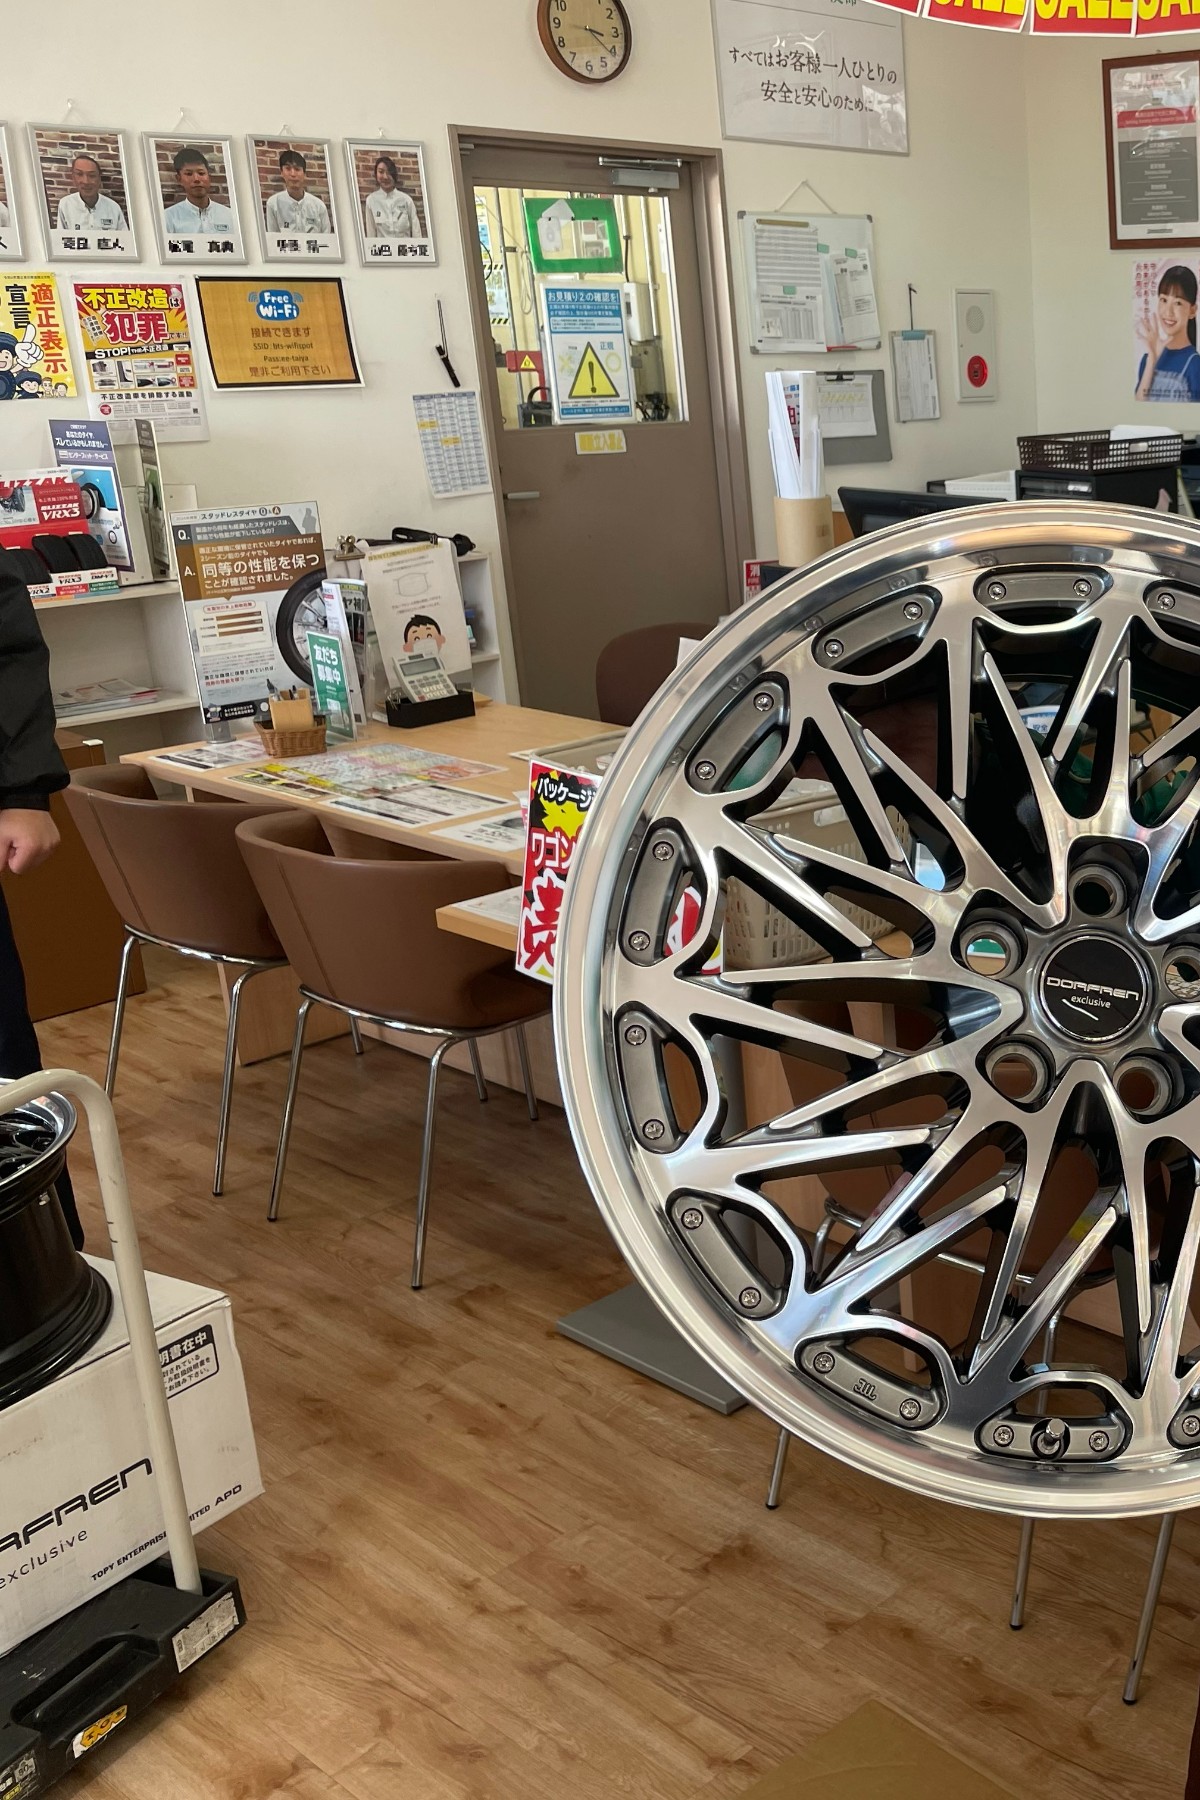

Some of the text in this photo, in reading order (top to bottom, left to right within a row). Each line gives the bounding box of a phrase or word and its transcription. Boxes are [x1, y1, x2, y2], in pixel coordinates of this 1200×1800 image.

[606, 8, 613, 20] 2
[553, 17, 561, 28] 9
[612, 27, 619, 38] 3
[558, 37, 565, 47] 8
[569, 51, 577, 63] 7
[610, 45, 616, 57] 4
[585, 61, 593, 72] 6
[600, 57, 607, 68] 5
[728, 46, 897, 84] すべてはお客様一人ひとりの
[760, 79, 874, 113] 安全と安心のために
[264, 292, 289, 303] Free
[259, 303, 297, 318] Wi-Fi
[31, 283, 67, 374] 適正表示
[251, 327, 311, 338] 接続できます
[42, 508, 81, 521] VRX3
[202, 553, 320, 579] 同等の性能を保つ
[313, 643, 338, 665] 友だち
[1070, 995, 1111, 1009] exclusive
[0, 1529, 88, 1589] exclusive
[92, 1563, 114, 1581] TOPY
